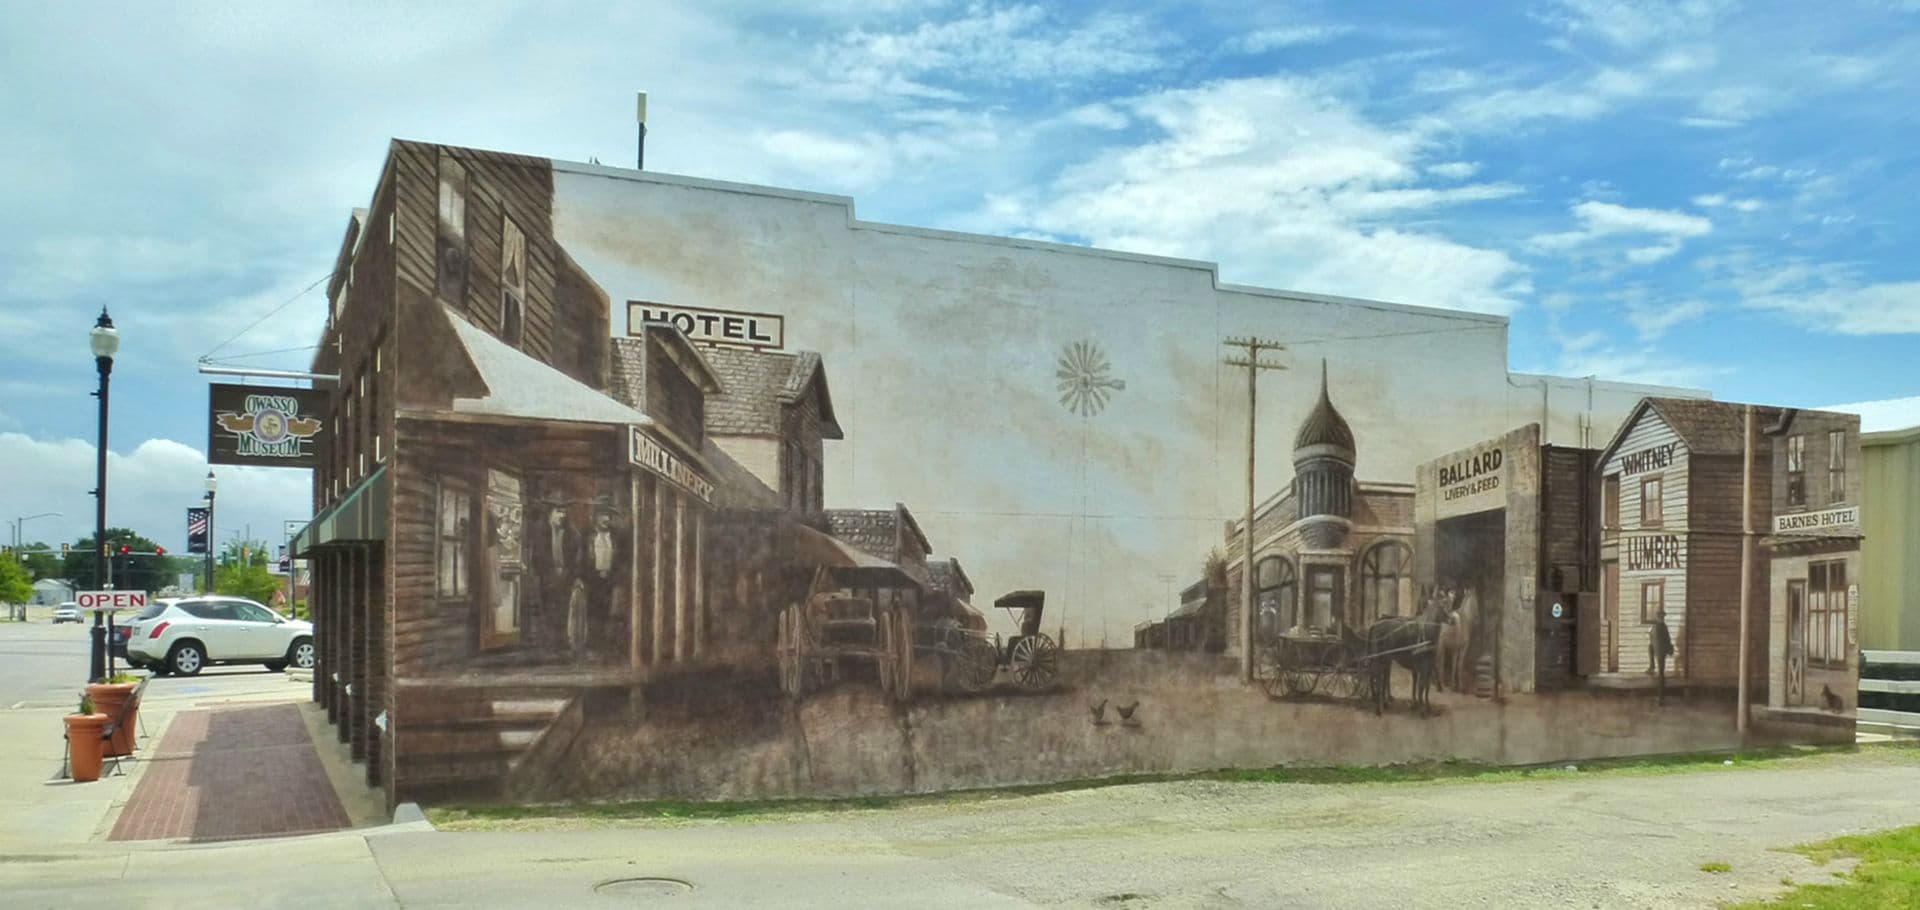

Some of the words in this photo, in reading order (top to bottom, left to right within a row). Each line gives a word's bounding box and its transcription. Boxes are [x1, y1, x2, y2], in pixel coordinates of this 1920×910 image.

[246, 395, 298, 417] OWASSO
[238, 432, 301, 456] MUSEUM
[634, 430, 714, 503] MILLINERY
[1439, 448, 1503, 488] BALLARD
[1621, 444, 1677, 476] WHITNEY
[1779, 514, 1819, 530] BARNES
[1821, 510, 1855, 526] HOTEL
[1628, 534, 1681, 570] LUMBER
[79, 594, 145, 608] OPEN
